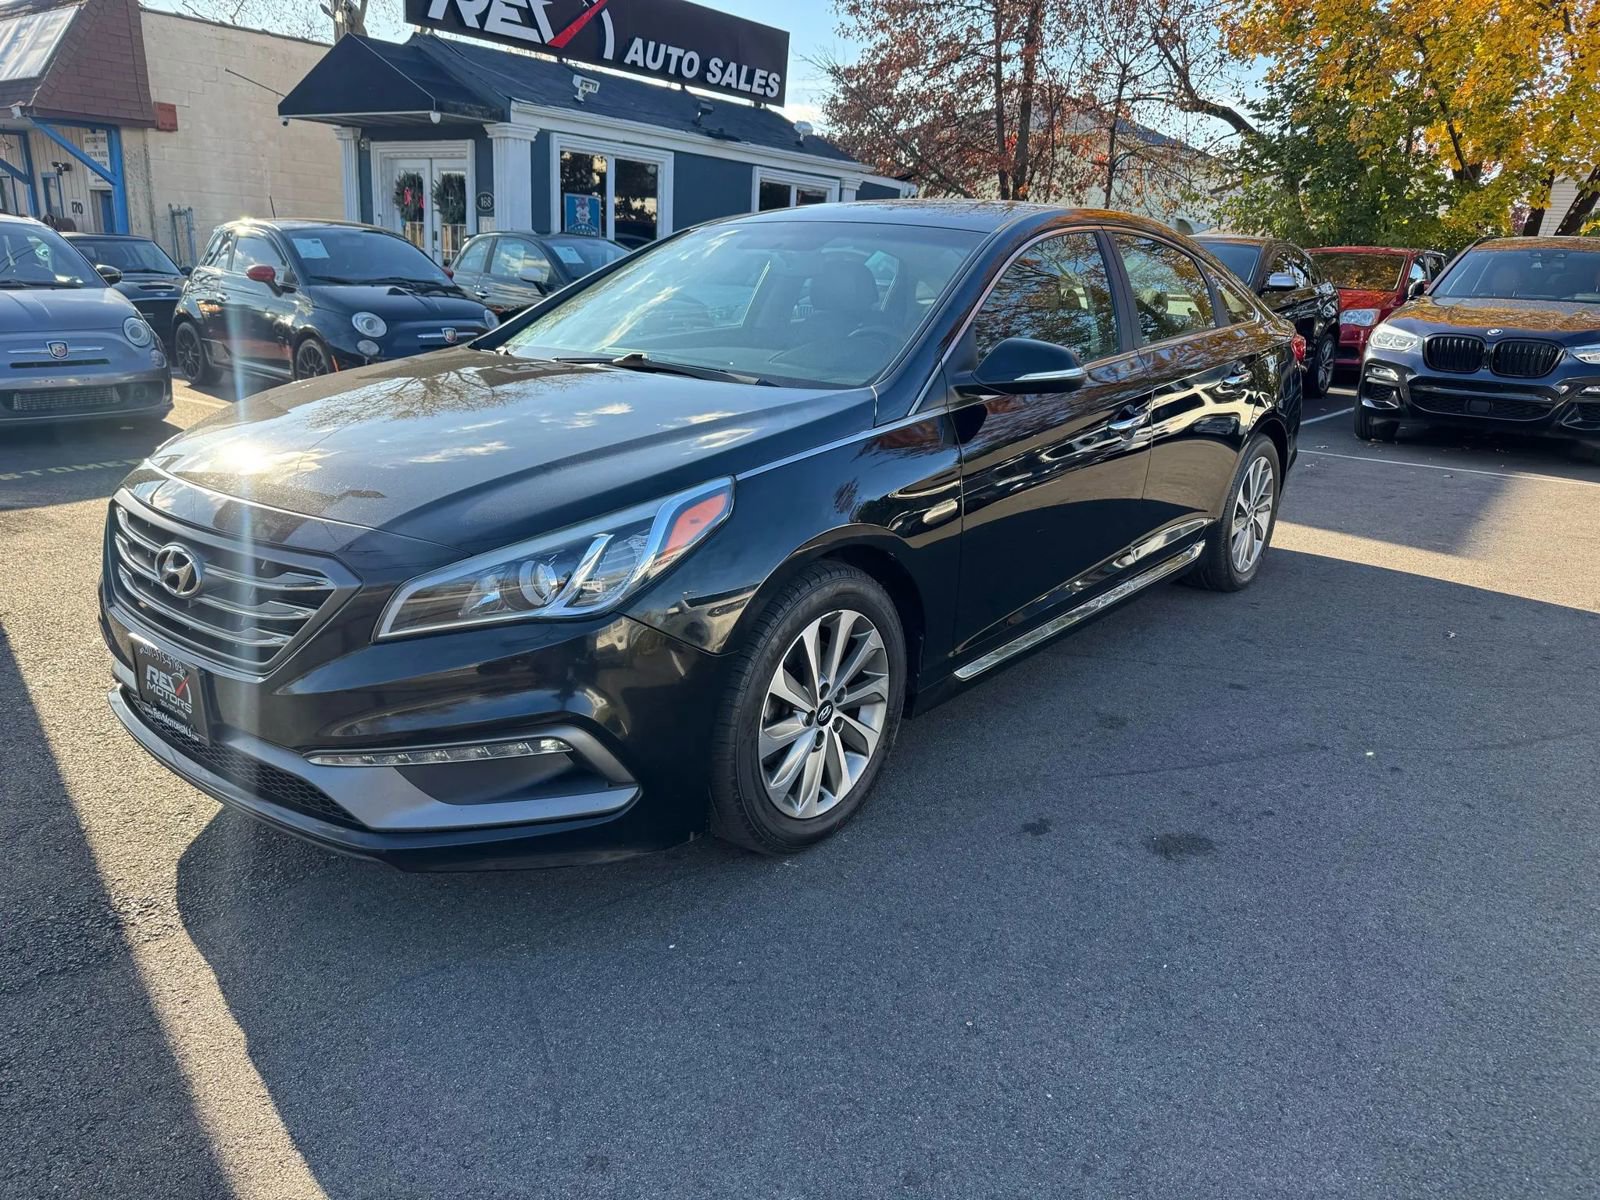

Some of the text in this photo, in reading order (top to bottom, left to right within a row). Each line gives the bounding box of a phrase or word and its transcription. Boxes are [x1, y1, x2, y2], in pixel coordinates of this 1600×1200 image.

[624, 37, 781, 98] AUTO SALES
[146, 680, 193, 714] MOTORS
